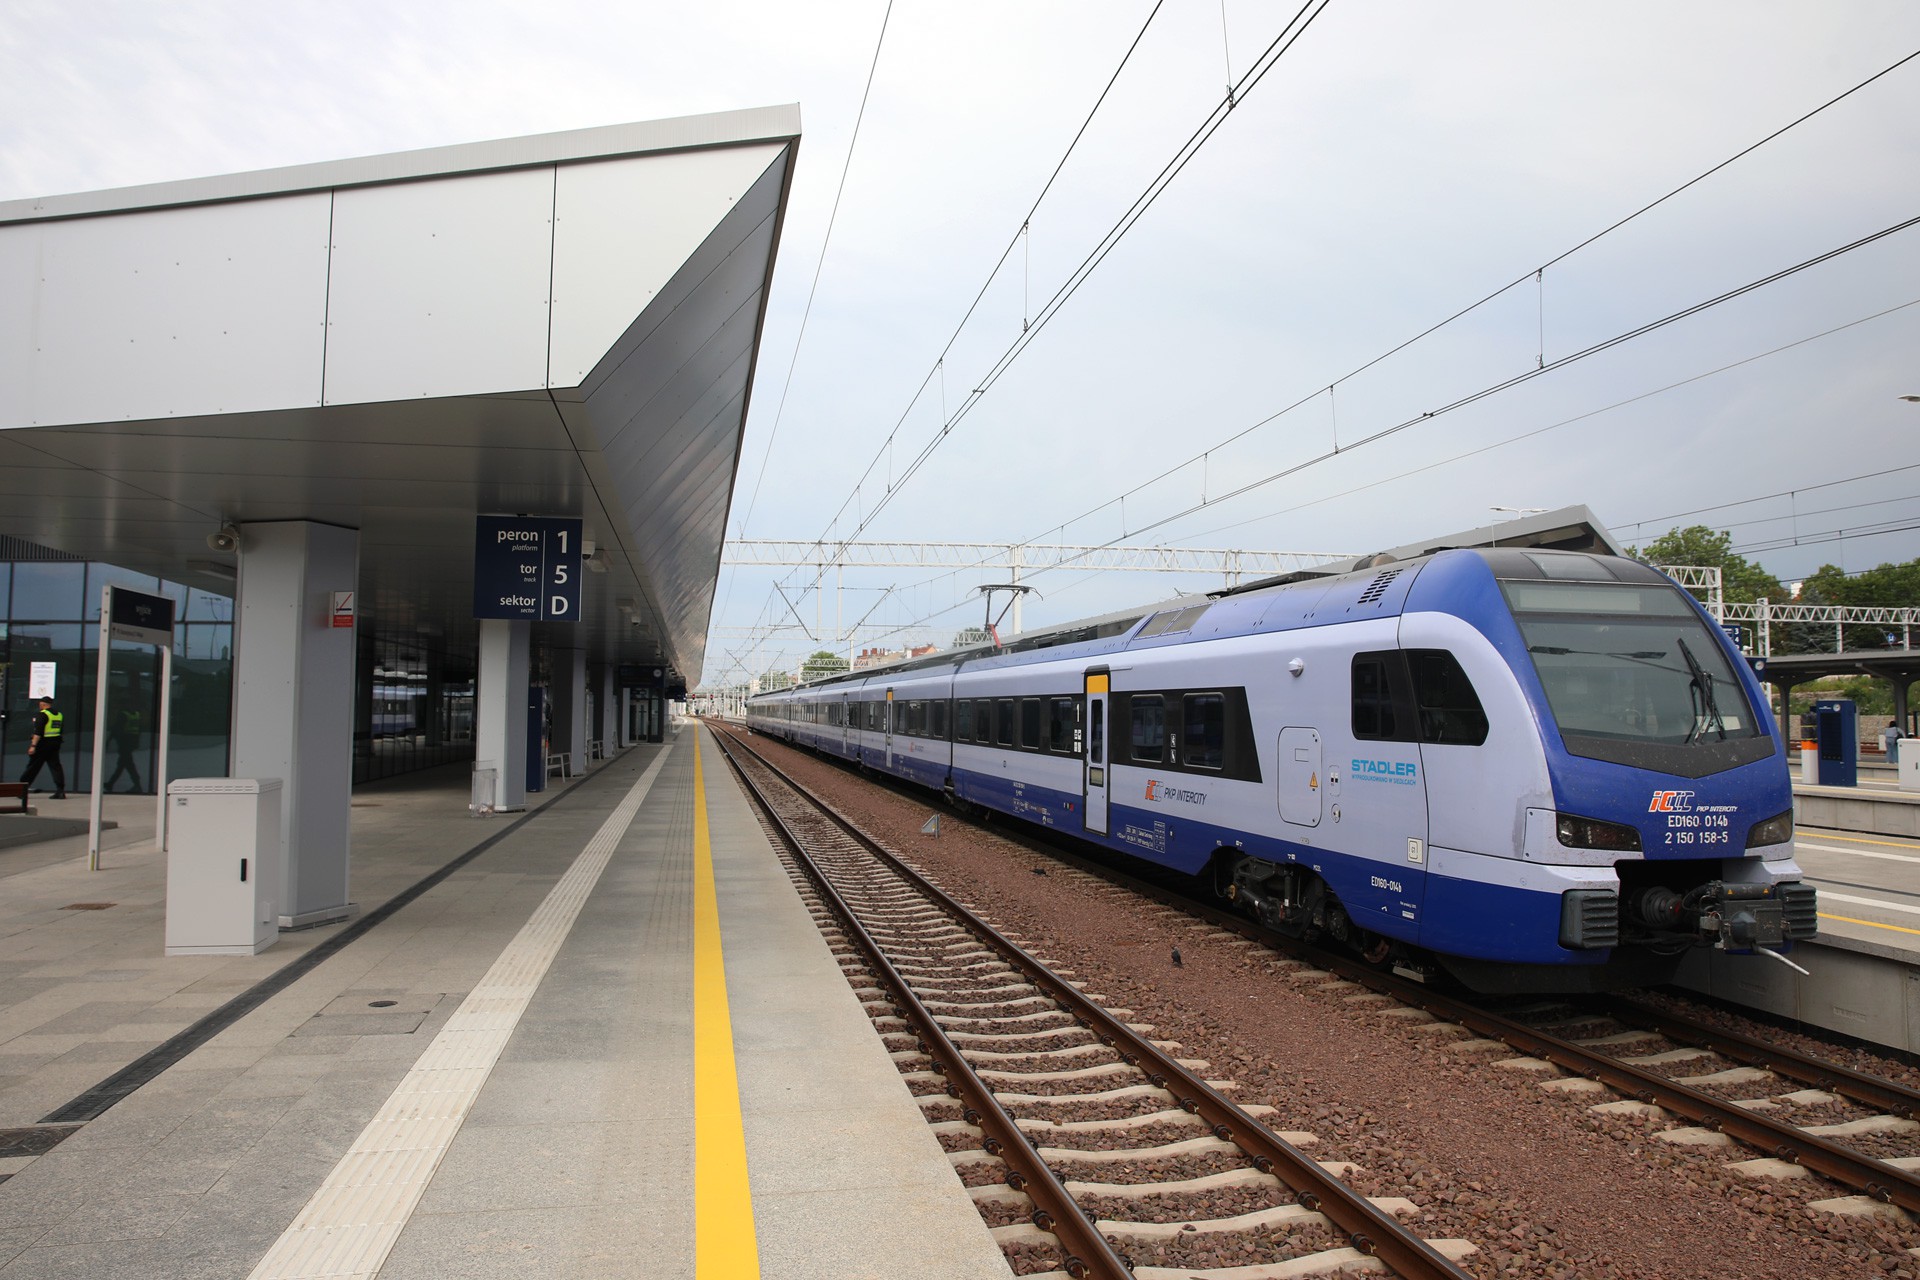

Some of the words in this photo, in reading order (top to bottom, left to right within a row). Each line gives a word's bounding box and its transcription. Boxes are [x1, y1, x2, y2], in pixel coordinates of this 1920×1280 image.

[497, 530, 538, 543] peron
[557, 531, 568, 554] 1
[512, 544, 538, 552] platform
[520, 564, 537, 574] tor
[554, 565, 568, 584] 5
[500, 594, 536, 606] sektor
[551, 596, 569, 615] D
[1351, 759, 1416, 777] STADLER
[1164, 787, 1177, 800] PKP
[1176, 789, 1208, 805] INTERCITY
[1668, 815, 1699, 827] ED160
[1705, 815, 1729, 827] 014b
[1664, 832, 1673, 844] 2
[1676, 832, 1694, 844] 150
[1699, 831, 1729, 844] 158-5
[1371, 875, 1402, 893] ED160-014b
